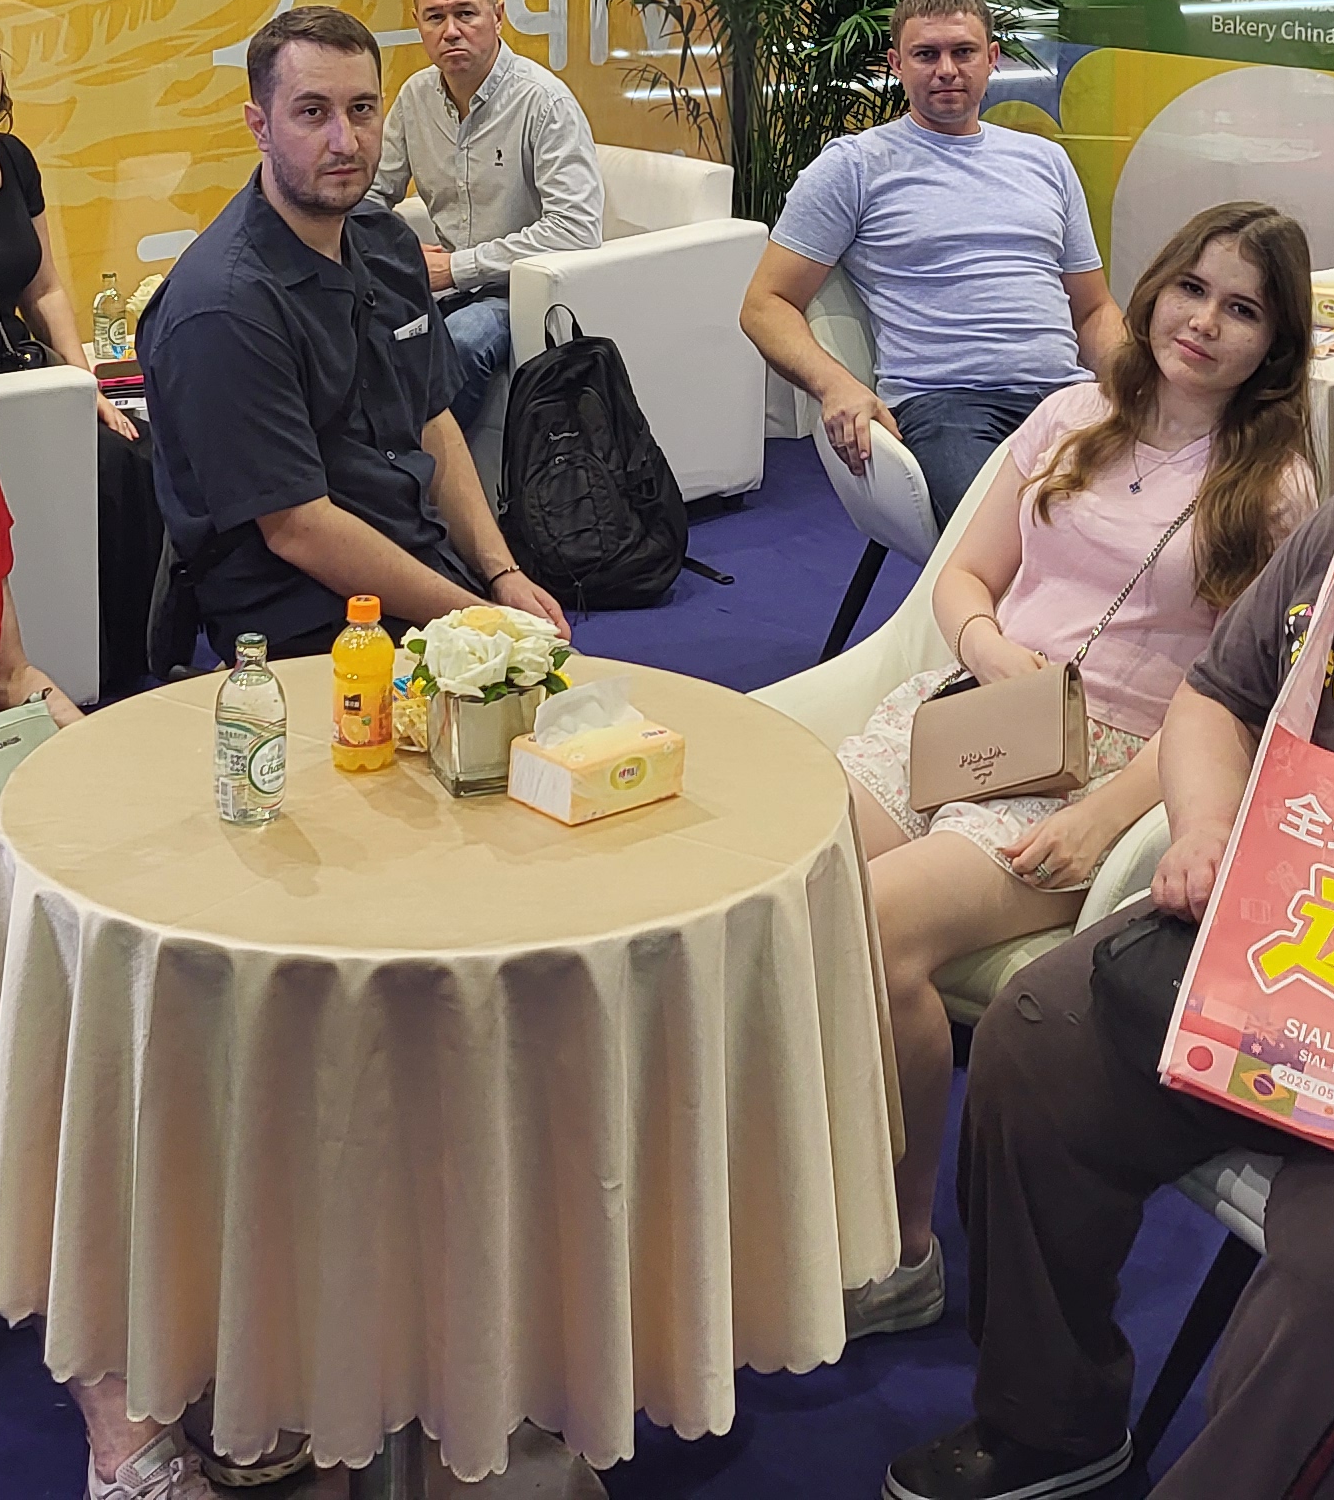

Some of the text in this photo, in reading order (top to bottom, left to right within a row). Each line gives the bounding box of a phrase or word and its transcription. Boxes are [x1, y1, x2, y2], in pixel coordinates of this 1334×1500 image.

[1211, 14, 1277, 42] Bakery
[958, 745, 1007, 768] PRADA
[1283, 1017, 1334, 1053] SIAL
[1298, 1049, 1327, 1069] SIAL
